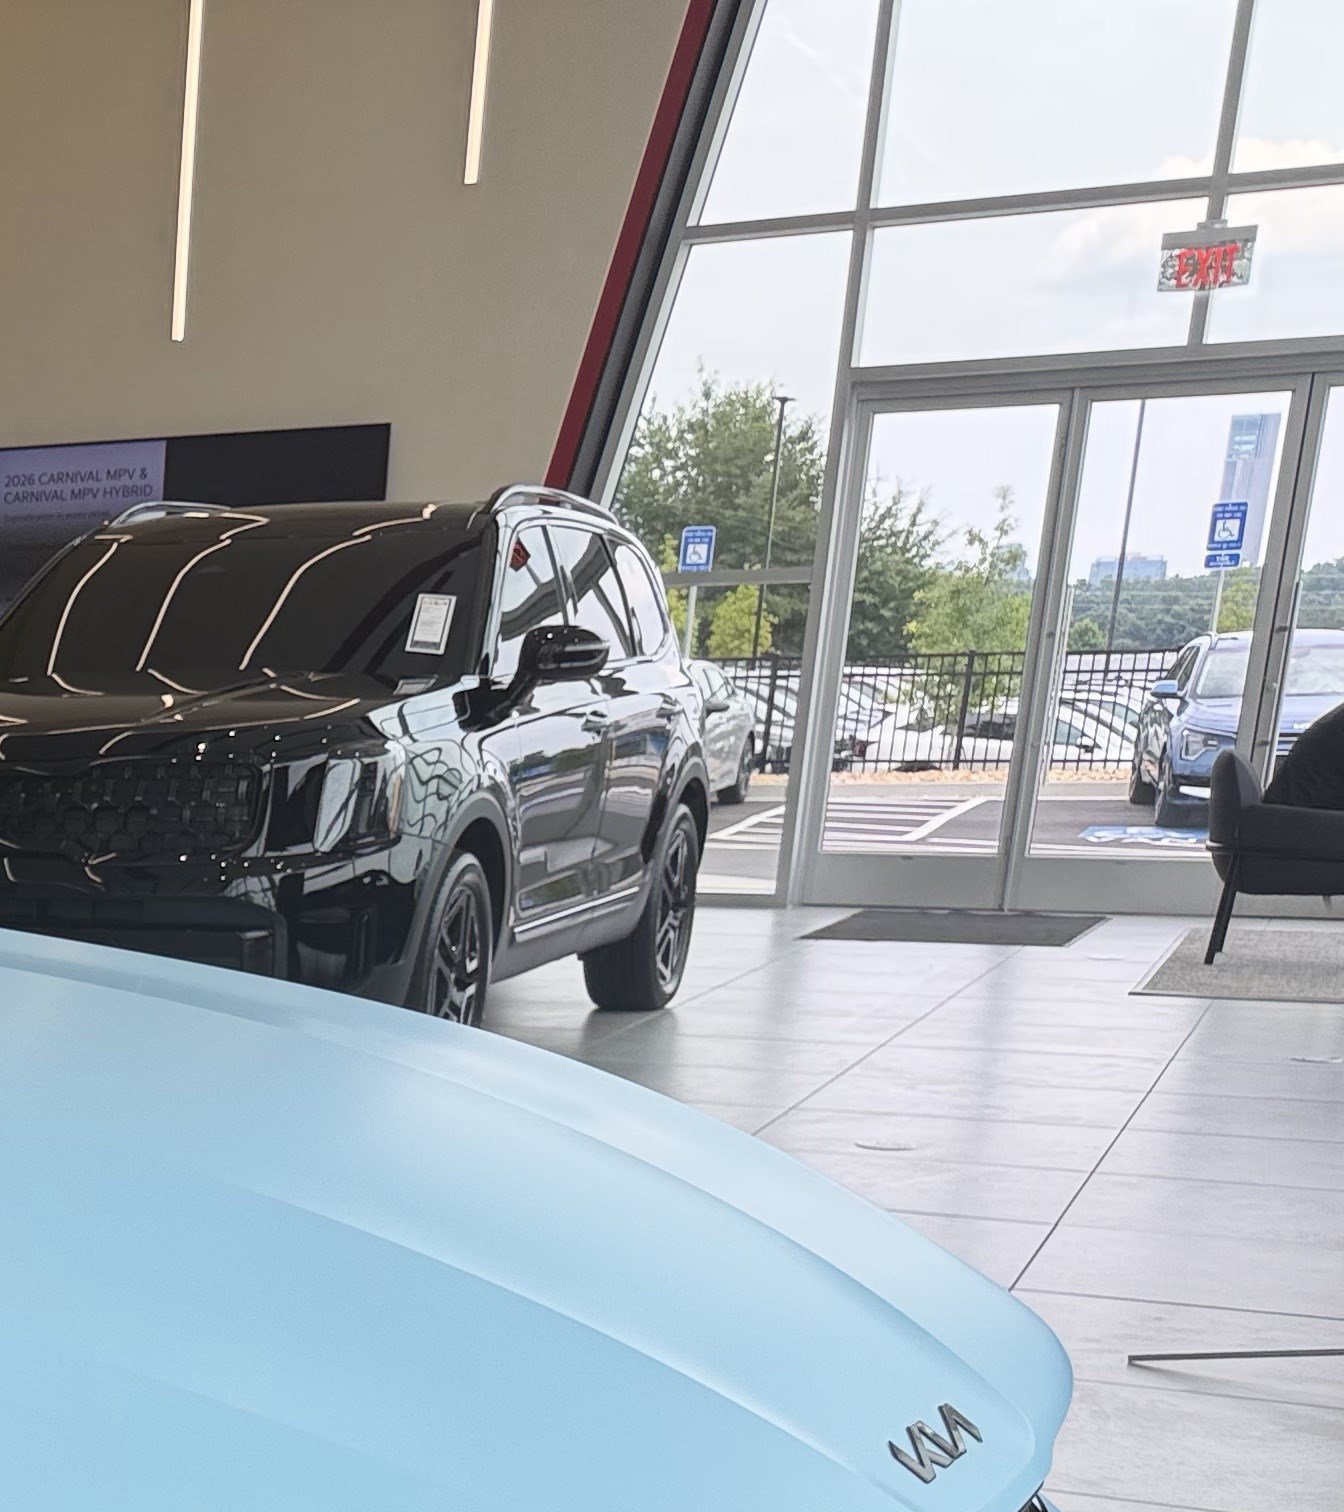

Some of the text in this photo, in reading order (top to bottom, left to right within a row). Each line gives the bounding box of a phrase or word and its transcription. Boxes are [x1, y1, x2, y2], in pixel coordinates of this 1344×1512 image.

[1176, 243, 1239, 288] EXIT
[4, 467, 148, 488] 2026 CARNIVAL MPV &
[3, 484, 154, 505] CARNIVAL MPV HYBRID
[887, 1403, 983, 1484] KIA
